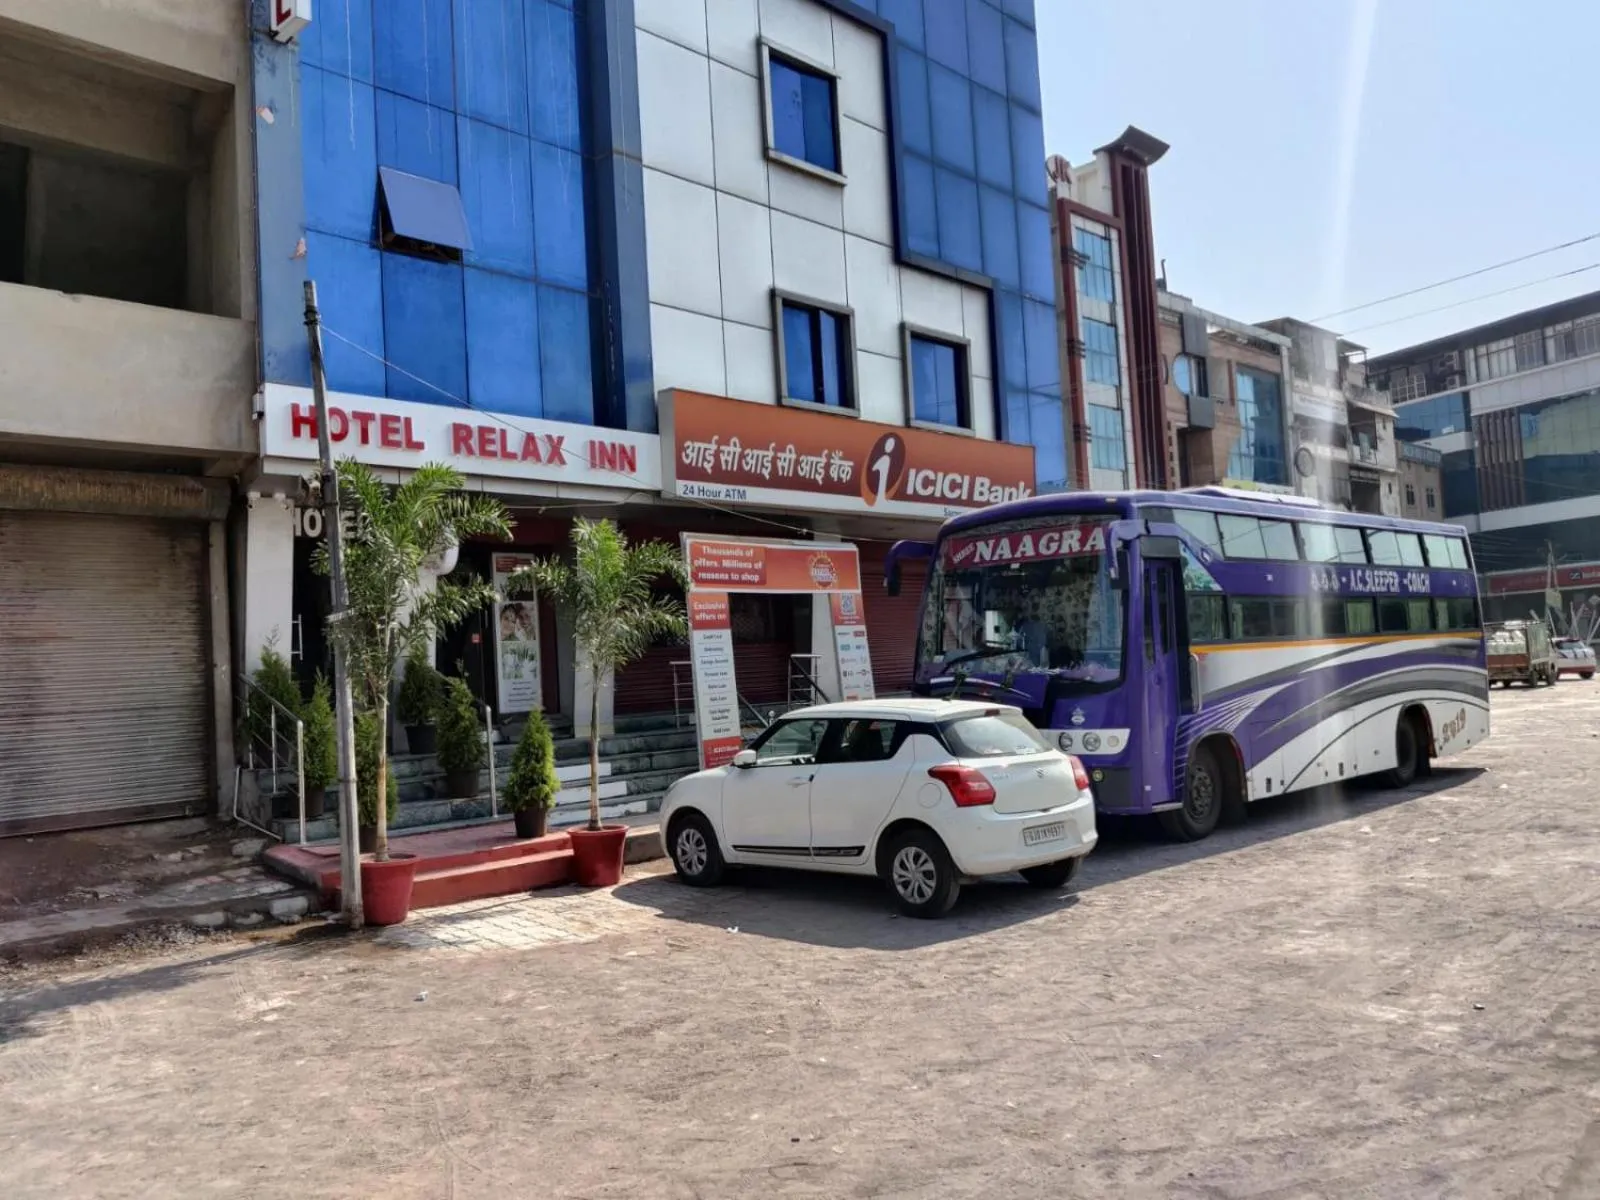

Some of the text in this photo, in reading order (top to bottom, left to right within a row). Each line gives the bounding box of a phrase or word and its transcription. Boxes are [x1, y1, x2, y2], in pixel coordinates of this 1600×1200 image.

[290, 402, 637, 473] HOTEL RELAX INN
[682, 435, 719, 474] आई
[720, 437, 741, 471] सी
[743, 442, 776, 479] आई
[777, 444, 797, 477] सी
[798, 449, 828, 485] आई
[682, 484, 747, 500] 24 Hour ATM
[906, 467, 1033, 504] ICICI Bank
[702, 545, 753, 557] Thousands of
[973, 527, 1106, 563] NAAGRA
[722, 559, 752, 569] Millions
[754, 561, 762, 570] of
[730, 572, 739, 580] to
[741, 573, 760, 583] shop
